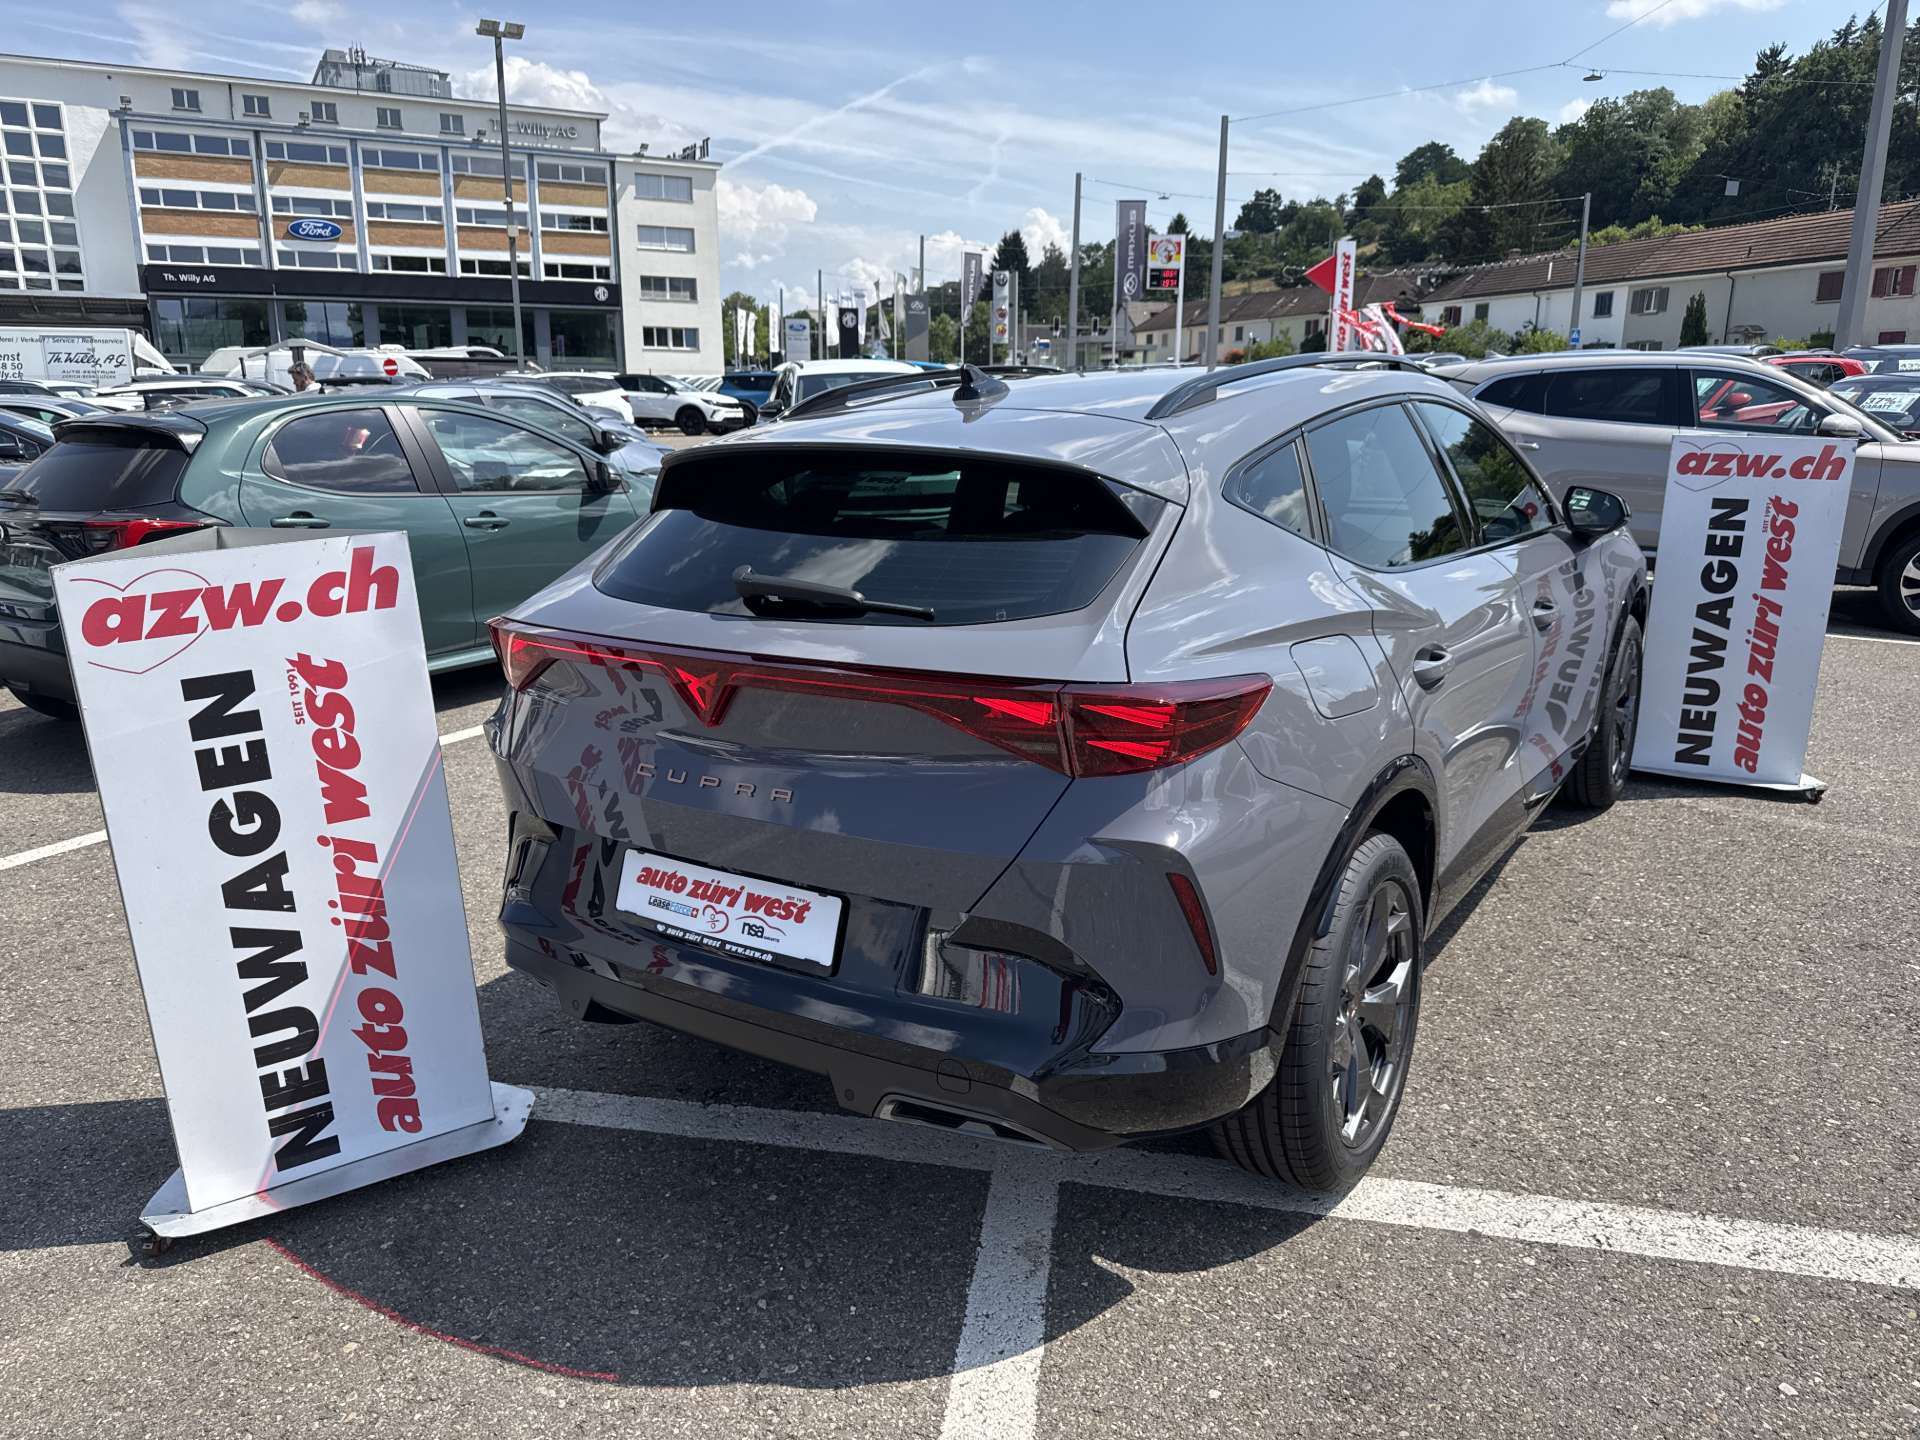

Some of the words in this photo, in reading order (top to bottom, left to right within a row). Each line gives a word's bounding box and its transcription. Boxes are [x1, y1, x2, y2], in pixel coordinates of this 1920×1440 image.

[517, 121, 552, 140] Willy
[556, 125, 578, 138] AG
[299, 221, 332, 237] Ford
[162, 273, 177, 281] Th.
[178, 273, 201, 284] Willy
[202, 275, 216, 283] AG
[10, 362, 23, 370] 50
[103, 354, 127, 368] AG
[1676, 445, 1847, 481] azw.ch
[1760, 495, 1798, 590] west
[82, 546, 399, 647] azw.ch
[1674, 498, 1749, 766] NEUWAGEN
[1745, 593, 1783, 684] züri
[286, 668, 300, 696] 1991
[292, 701, 305, 725] SEIT
[1733, 683, 1769, 774] auto
[285, 652, 381, 825] west
[636, 762, 793, 803] CUPRA
[316, 835, 398, 977] züri
[636, 866, 688, 894] auto
[687, 878, 745, 907] züri
[743, 891, 812, 924] west
[180, 670, 340, 1171] NEUWAGEN
[741, 921, 765, 939] nsa
[666, 926, 684, 939] auto
[702, 935, 722, 948] west
[724, 943, 774, 962] www.azw.ch
[351, 985, 422, 1134] auto
